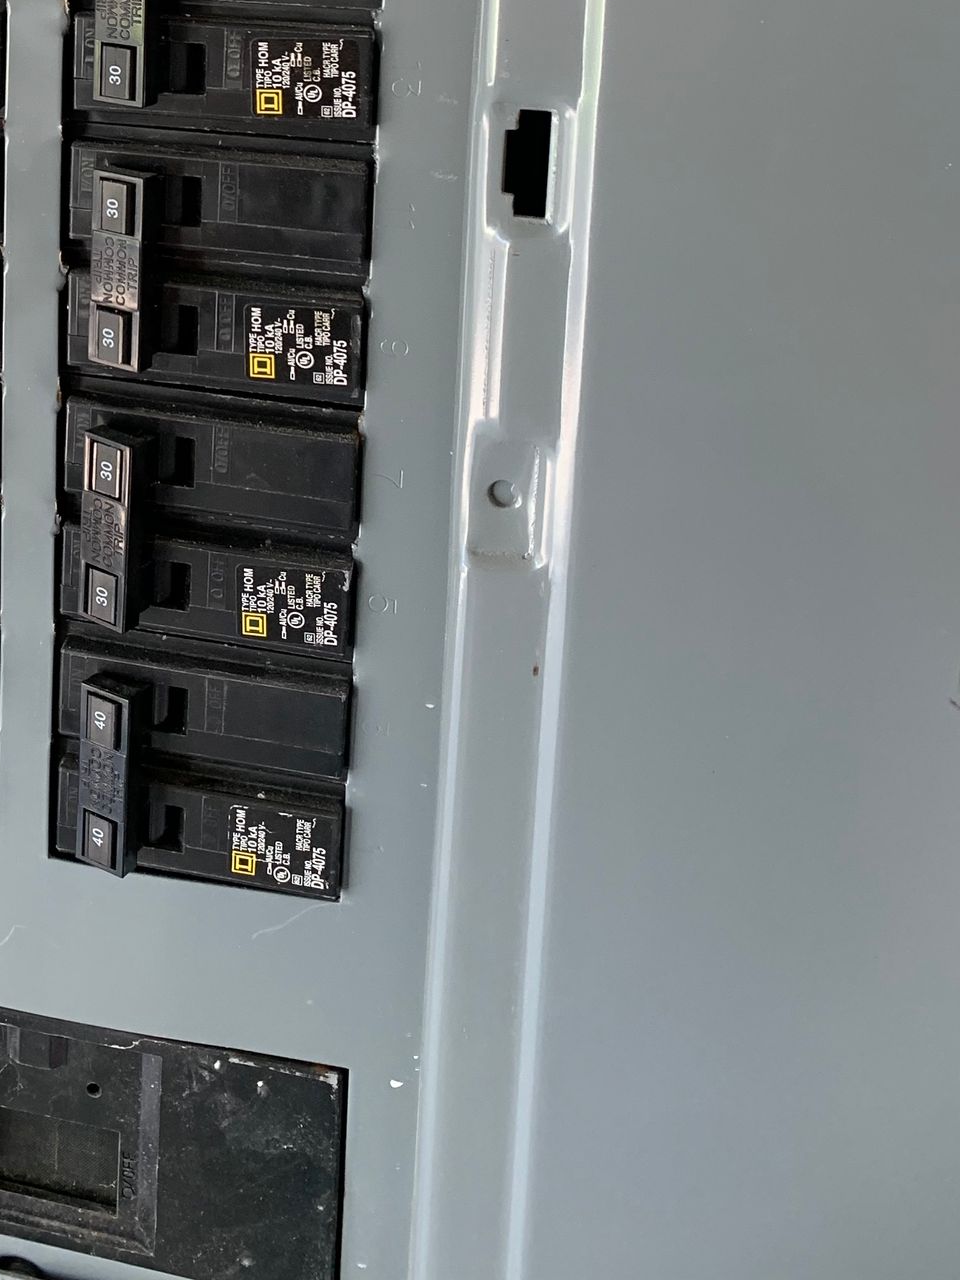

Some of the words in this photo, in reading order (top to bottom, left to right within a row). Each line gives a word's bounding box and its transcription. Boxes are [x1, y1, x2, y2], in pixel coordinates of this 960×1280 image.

[258, 42, 269, 67] HOM
[109, 65, 121, 85] 30
[342, 71, 356, 118] DP-4075
[107, 198, 118, 219] 30
[252, 307, 262, 332] HOM
[102, 328, 114, 348] 30
[265, 324, 274, 338] kA
[296, 324, 304, 348] LISTED
[249, 333, 257, 352] TYPE
[256, 335, 264, 352] TIPO
[265, 340, 274, 354] 10
[274, 329, 282, 354] 120/240
[334, 340, 348, 385] DP-4075
[325, 367, 333, 384] ISSUE
[101, 461, 112, 481] 30
[244, 568, 254, 591] HOM
[96, 587, 108, 606] 30
[324, 602, 338, 645] DP-4075
[94, 711, 106, 730] 40
[235, 809, 246, 832] HOM
[92, 828, 104, 847] 40
[312, 847, 326, 889] DP-4075
